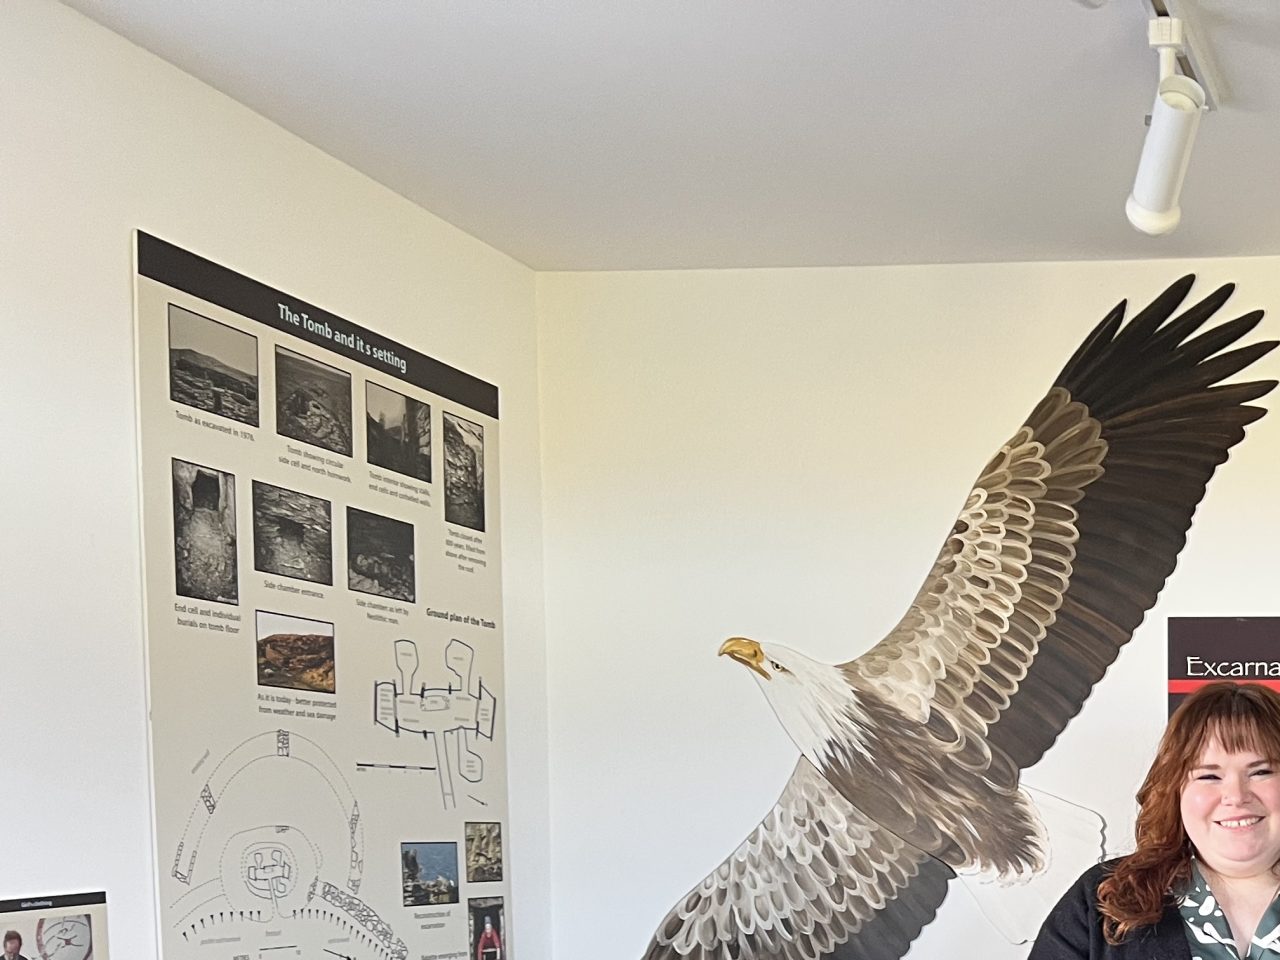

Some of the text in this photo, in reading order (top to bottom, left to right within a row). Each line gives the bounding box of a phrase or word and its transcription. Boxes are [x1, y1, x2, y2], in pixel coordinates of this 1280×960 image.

[278, 302, 299, 325] The
[301, 312, 332, 339] Tomb
[334, 331, 354, 349] and
[373, 347, 406, 374] setting
[175, 603, 186, 612] End
[427, 608, 495, 629] Ground plan of the Tomb
